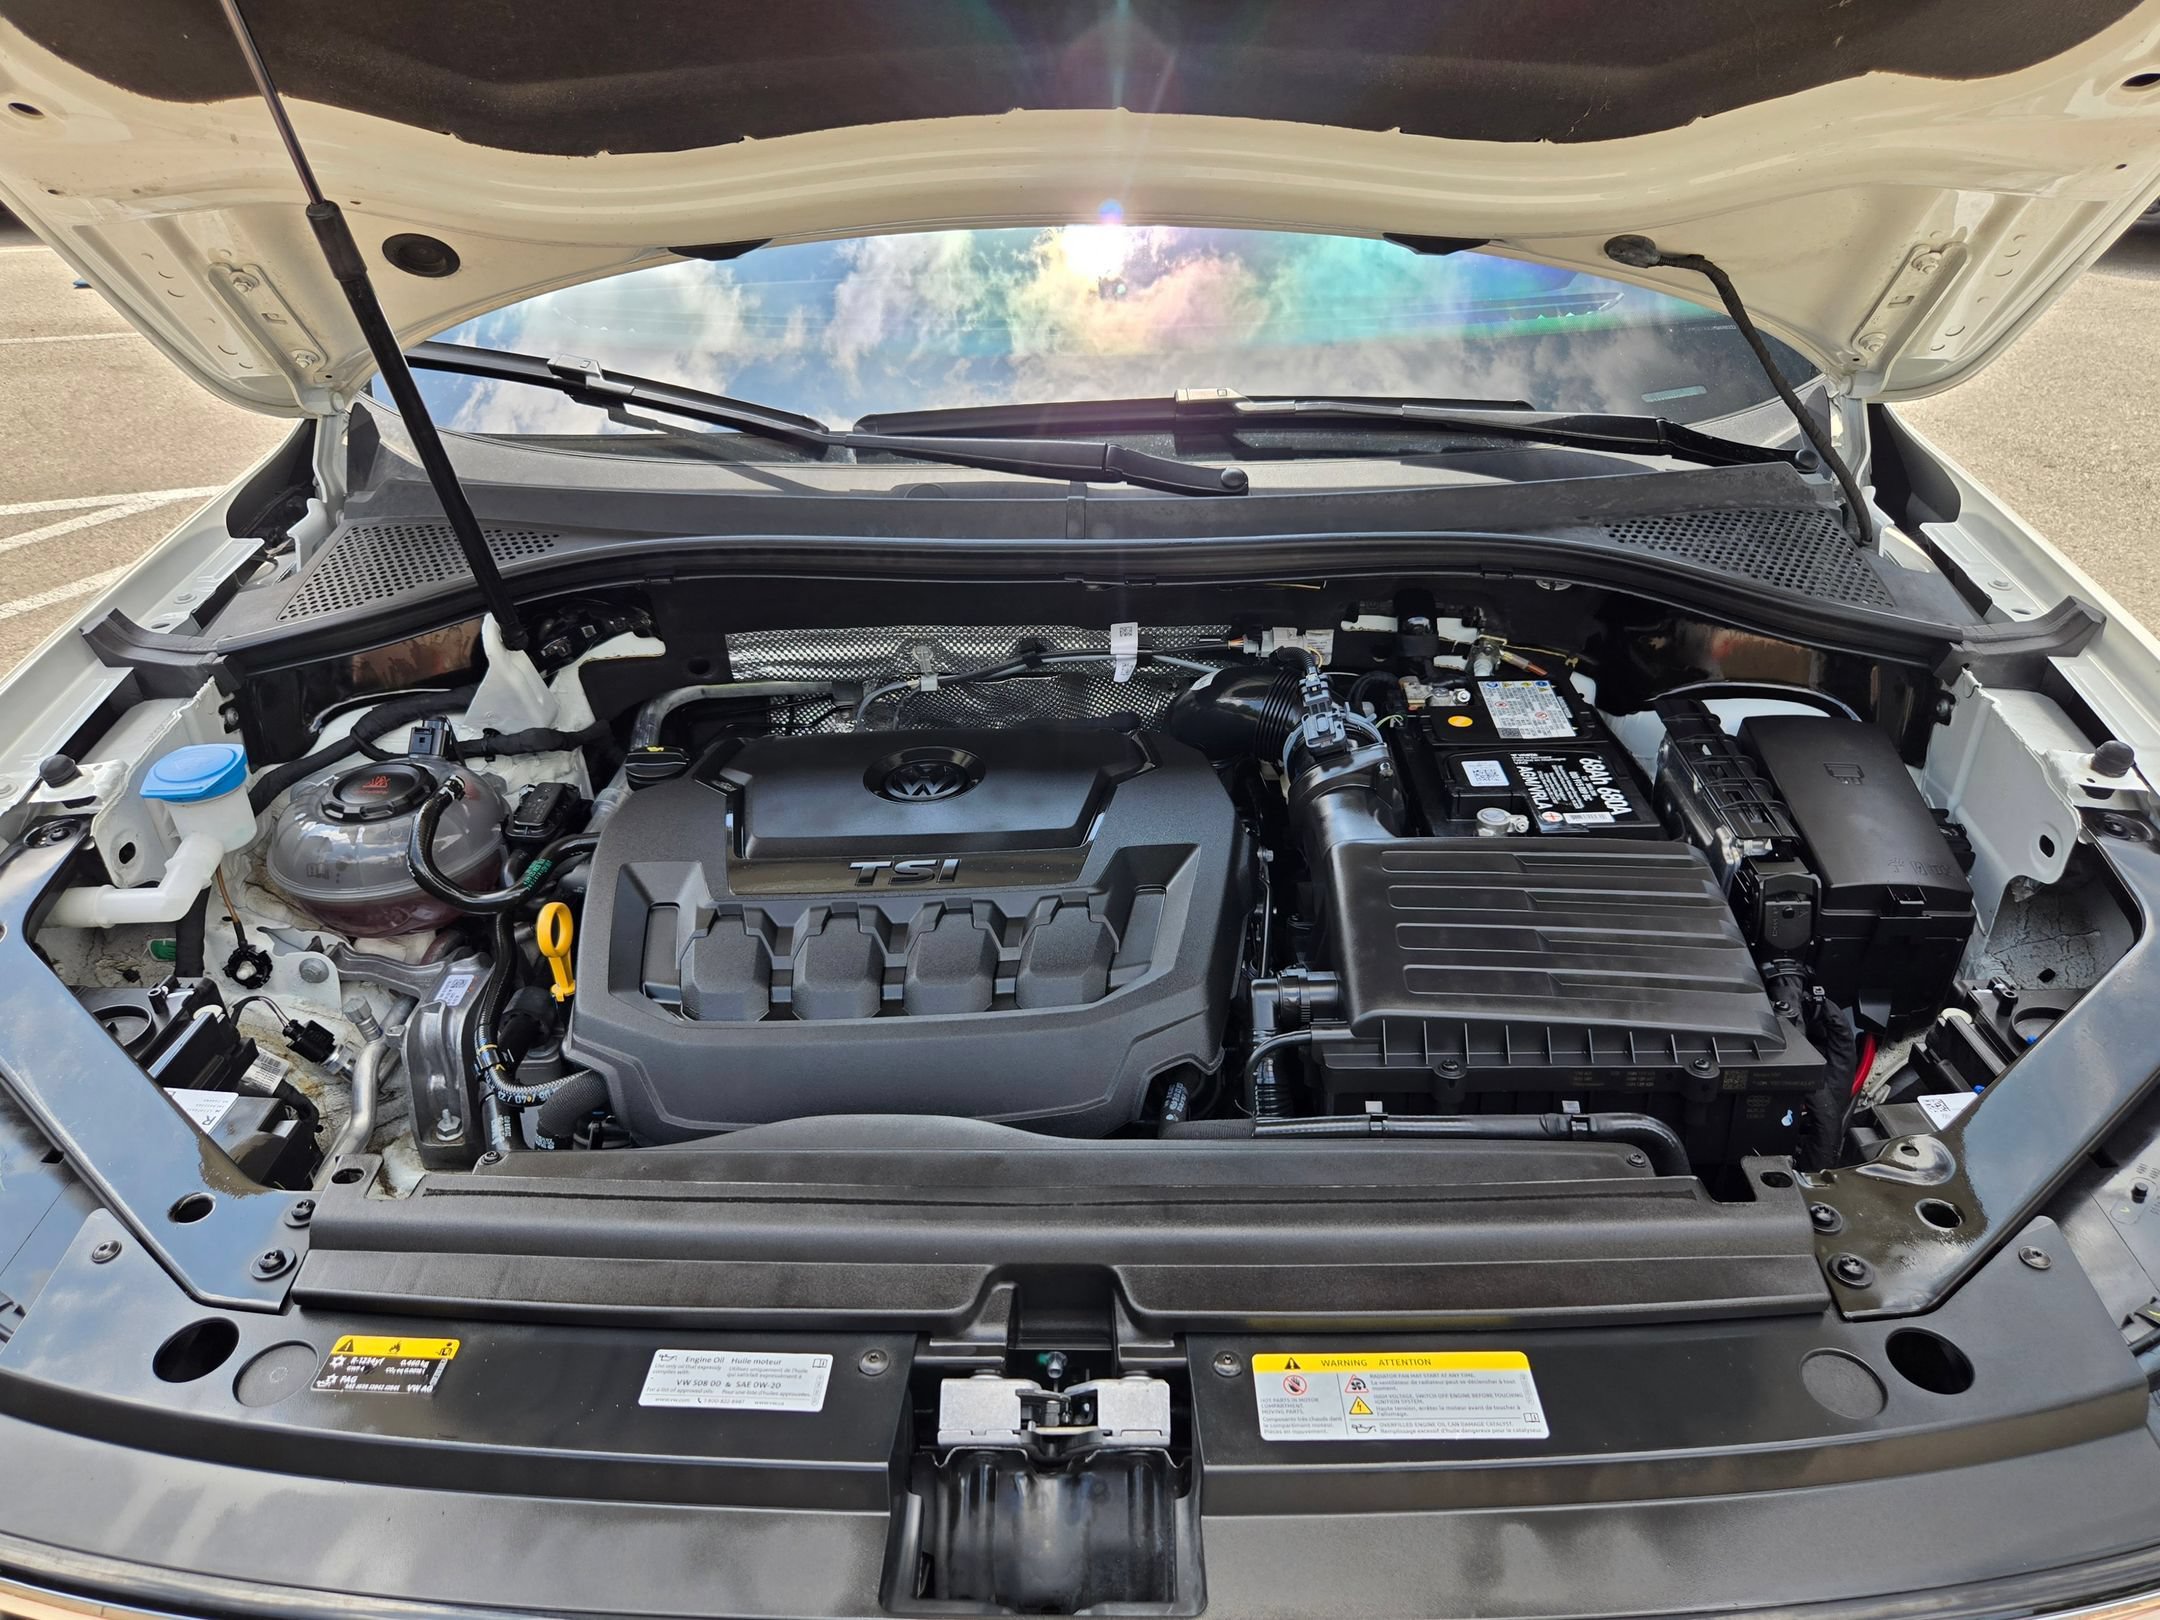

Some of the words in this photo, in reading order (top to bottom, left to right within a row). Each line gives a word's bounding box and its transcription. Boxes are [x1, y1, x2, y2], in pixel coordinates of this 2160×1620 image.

[1516, 766, 1553, 810] AGM/VRLA
[1580, 758, 1613, 785] 68Ah
[1597, 787, 1632, 815] 680A
[850, 858, 961, 886] TSI
[202, 1115, 216, 1126] R
[1320, 1359, 1368, 1367] WARNING
[1378, 1358, 1432, 1366] ATTENTION
[340, 1376, 358, 1384] PAG
[407, 1384, 420, 1392] VW
[420, 1385, 434, 1393] AG
